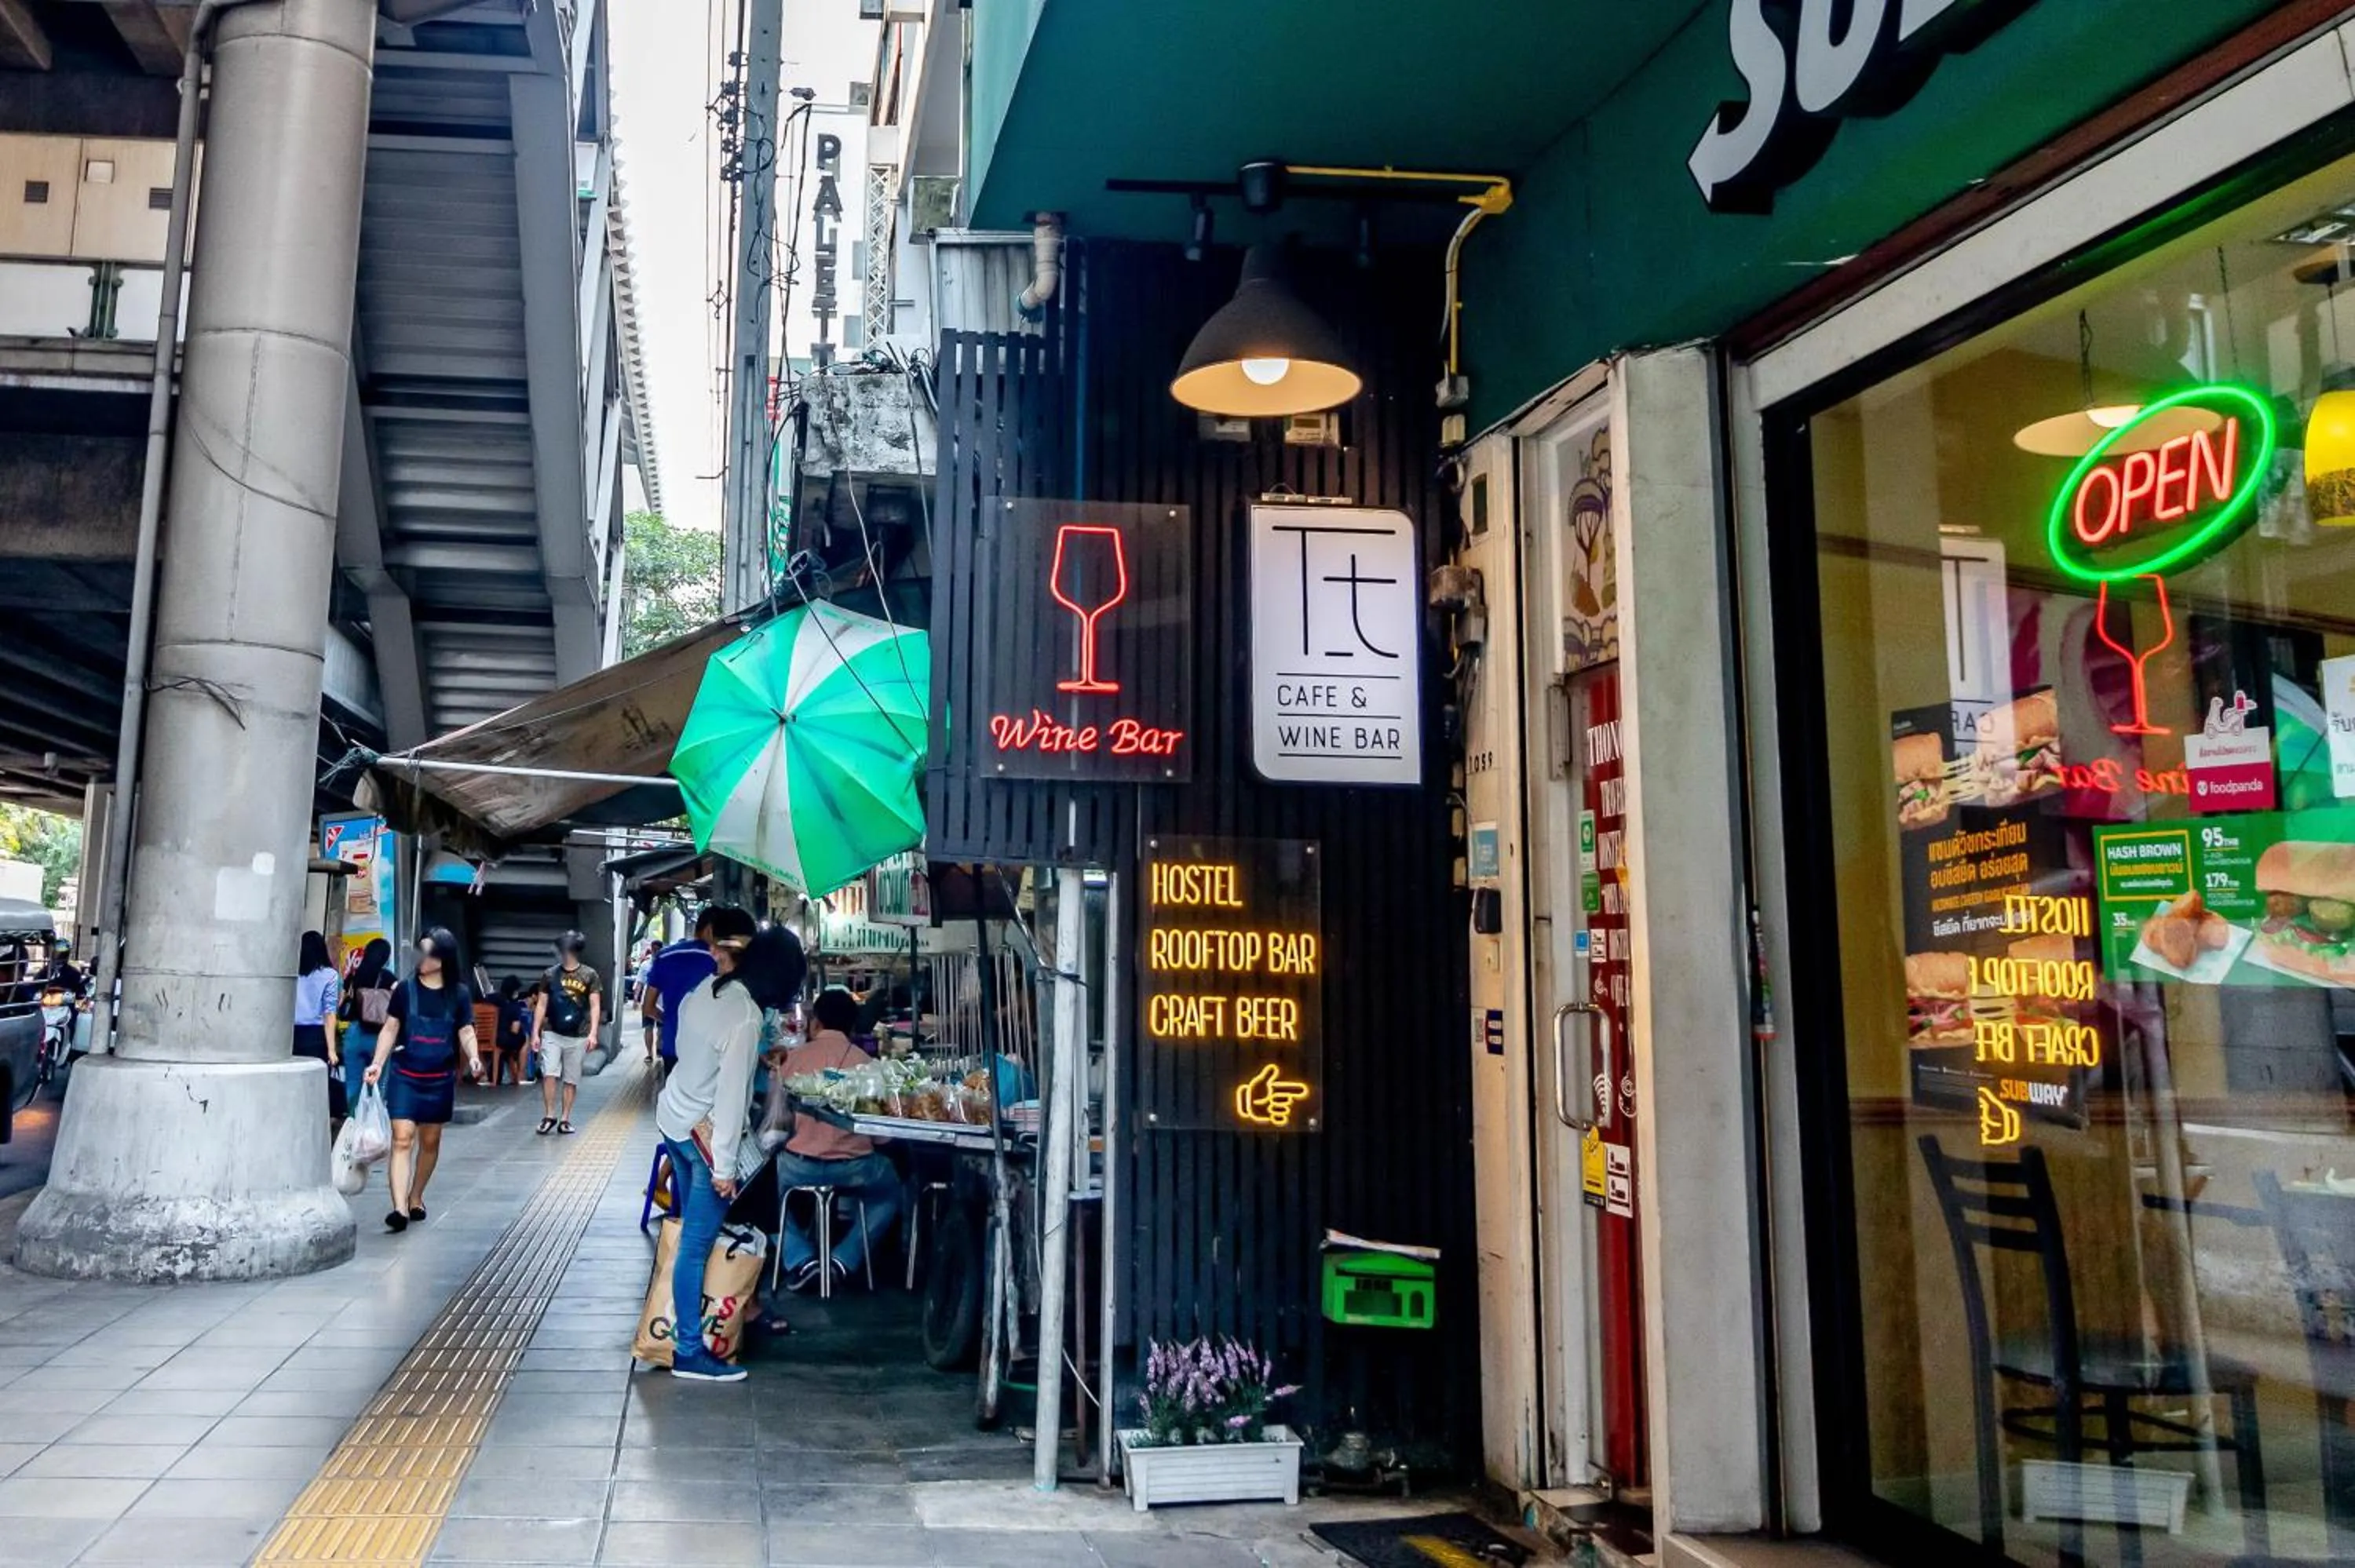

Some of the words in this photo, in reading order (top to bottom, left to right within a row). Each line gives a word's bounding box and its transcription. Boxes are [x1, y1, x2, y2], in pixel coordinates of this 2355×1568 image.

[2074, 416, 2238, 543] OPEN
[1276, 684, 1338, 707] CAFE
[1350, 686, 1367, 708] &
[990, 707, 1097, 752] Wine
[1108, 717, 1183, 755] Bar
[1278, 726, 1341, 748] WINE
[1354, 727, 1400, 749] BAR
[2210, 779, 2263, 796] foodpanda
[2201, 826, 2223, 848] 95
[2107, 845, 2137, 859] HASH
[2139, 842, 2182, 857] BROWN
[1151, 862, 1243, 906] HOSTEL
[2204, 873, 2228, 888] 179
[1151, 928, 1261, 971] ROOFTOP
[1268, 932, 1316, 974] BAR
[1149, 994, 1227, 1037] CRAFT
[1236, 996, 1297, 1041] BEER
[1999, 1078, 2068, 1107] SUBWAY
